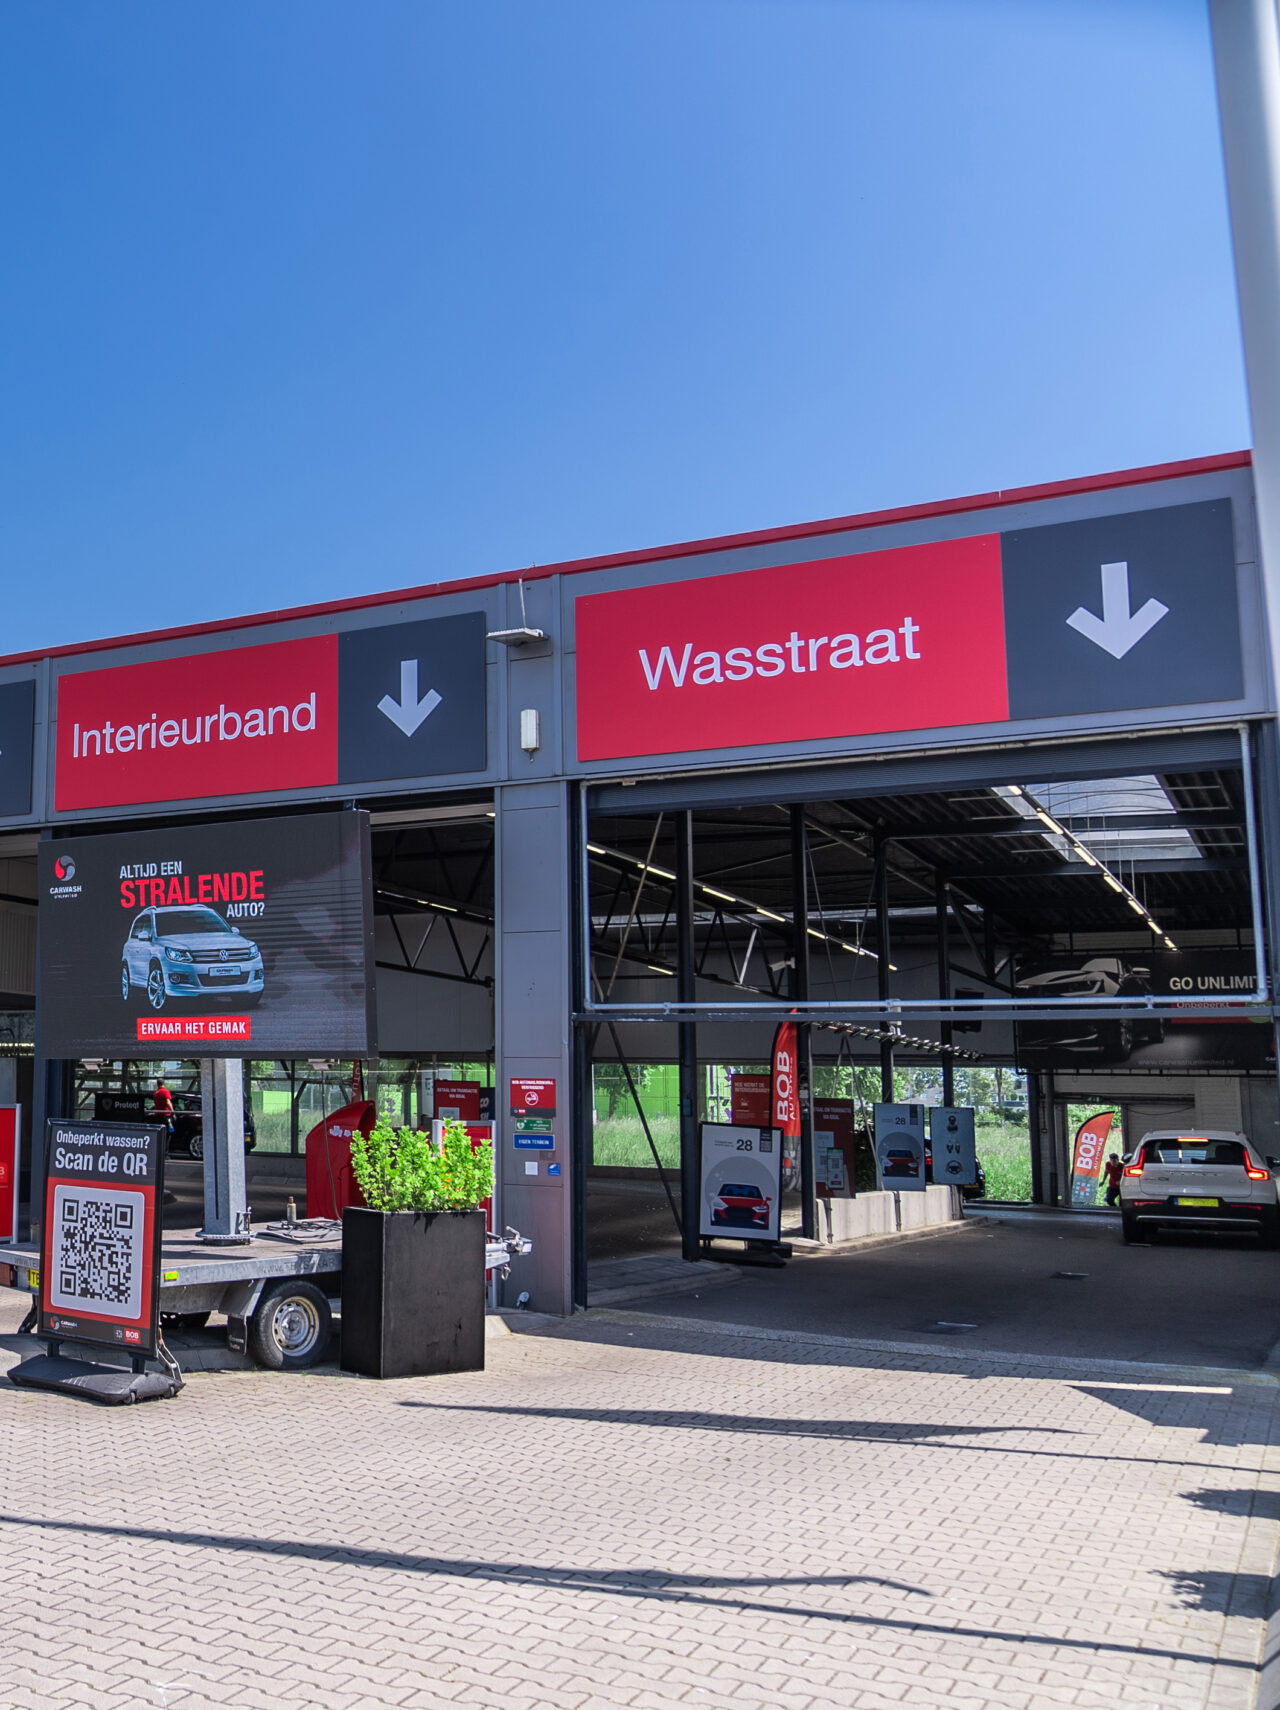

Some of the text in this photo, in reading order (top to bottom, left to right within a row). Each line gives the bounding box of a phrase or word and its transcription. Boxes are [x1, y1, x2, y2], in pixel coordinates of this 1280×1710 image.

[638, 616, 921, 691] Wasstraat
[72, 691, 317, 758] Interieurband
[120, 860, 183, 880] ALTIJD EEN
[49, 885, 82, 895] CARWASH
[120, 869, 265, 908] STRALENDE
[226, 901, 266, 918] AUTO?
[1169, 975, 1272, 990] GO UNLIMI
[141, 1021, 246, 1035] ERVAAR HET GEMAK
[777, 1051, 790, 1121] BOB
[895, 1117, 906, 1126] 28
[56, 1130, 151, 1149] Onbeperkt wassen?
[736, 1139, 753, 1152] 28
[1076, 1132, 1098, 1170] BOB
[55, 1147, 148, 1177] Scan de QR
[125, 1330, 139, 1339] BOB
